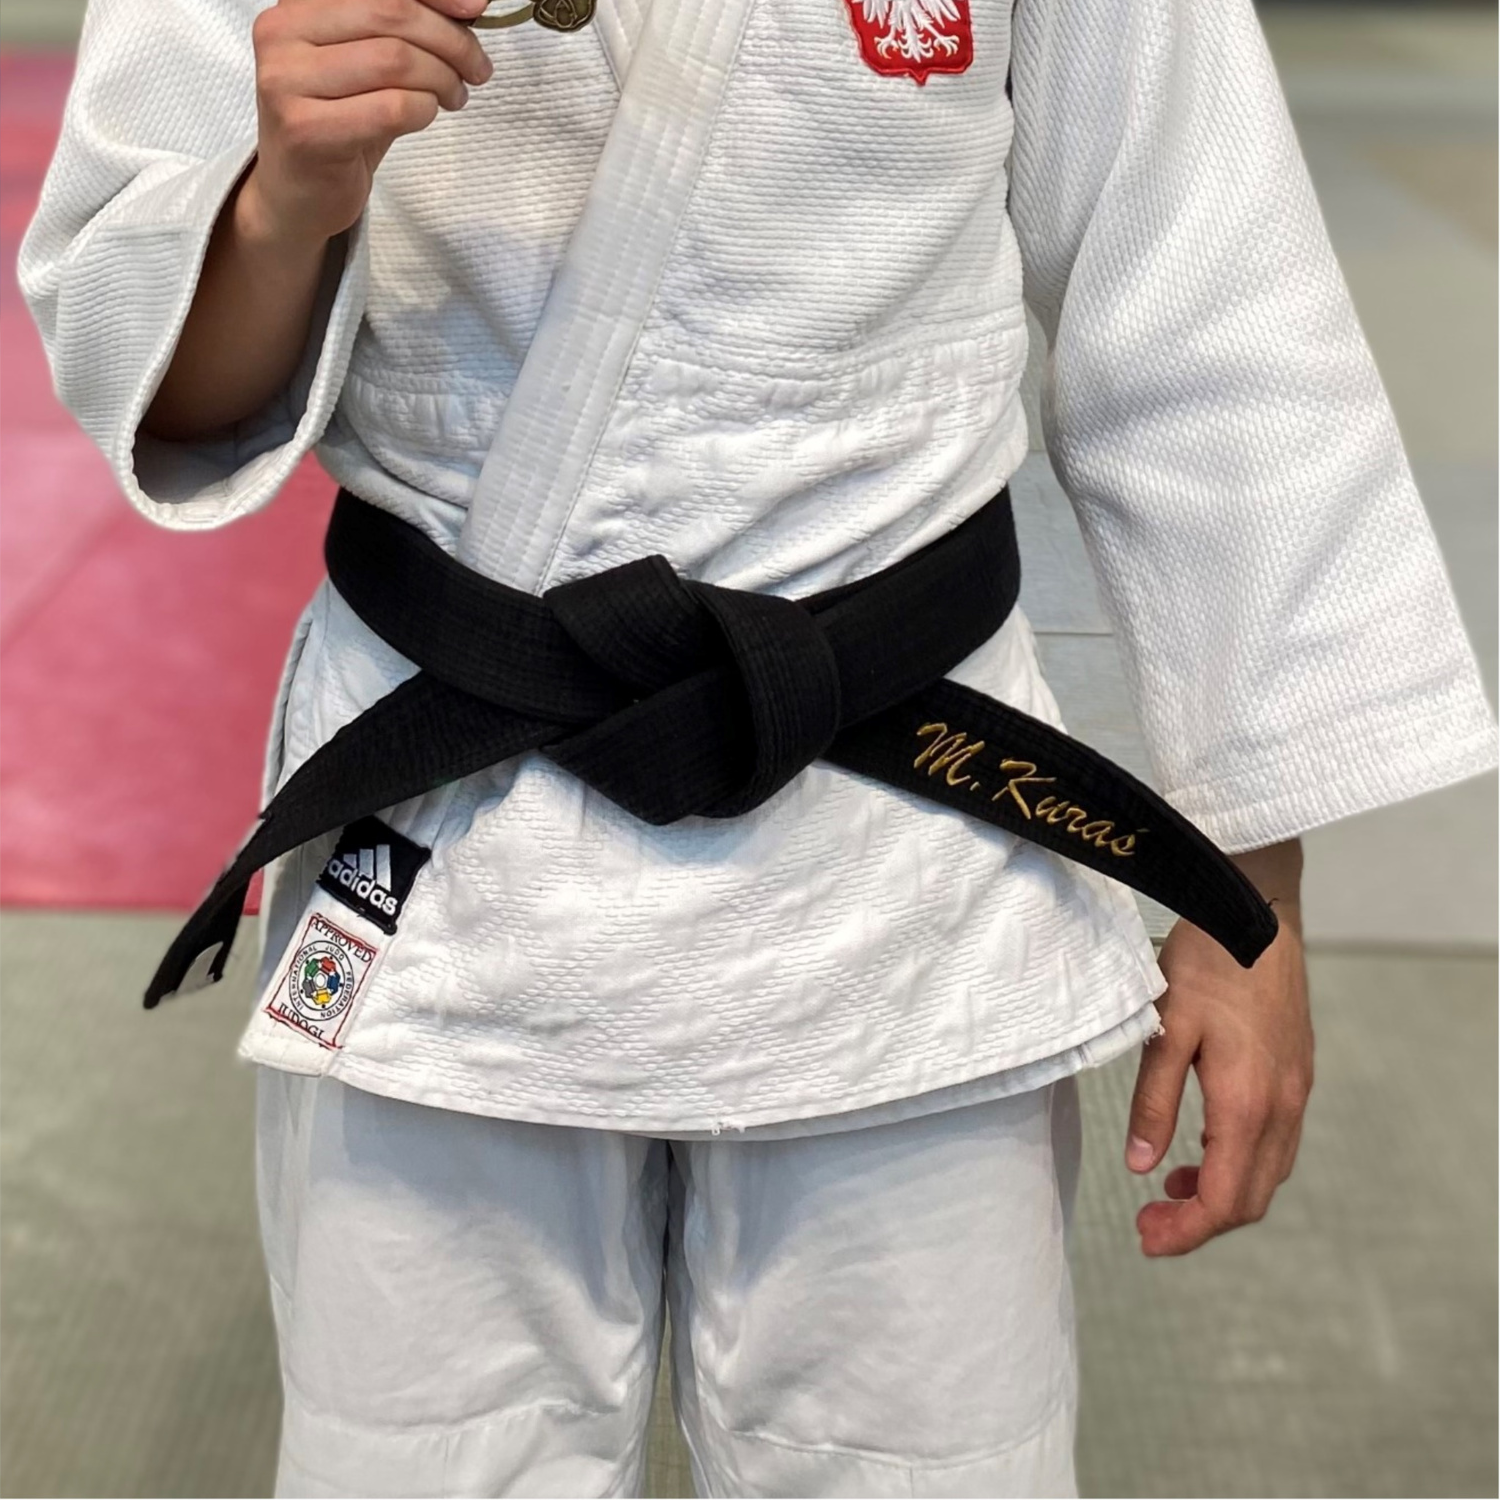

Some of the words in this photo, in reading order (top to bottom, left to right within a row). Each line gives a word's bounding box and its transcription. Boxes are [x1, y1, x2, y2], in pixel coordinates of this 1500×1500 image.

[913, 722, 985, 792] M.
[327, 856, 399, 917] adidas
[310, 918, 373, 964] APPROVED
[324, 945, 346, 962] JUDO
[290, 944, 318, 1011] INTERNATIONAL
[319, 970, 354, 1019] FEDERATION
[277, 1002, 326, 1041] JUDOGI
